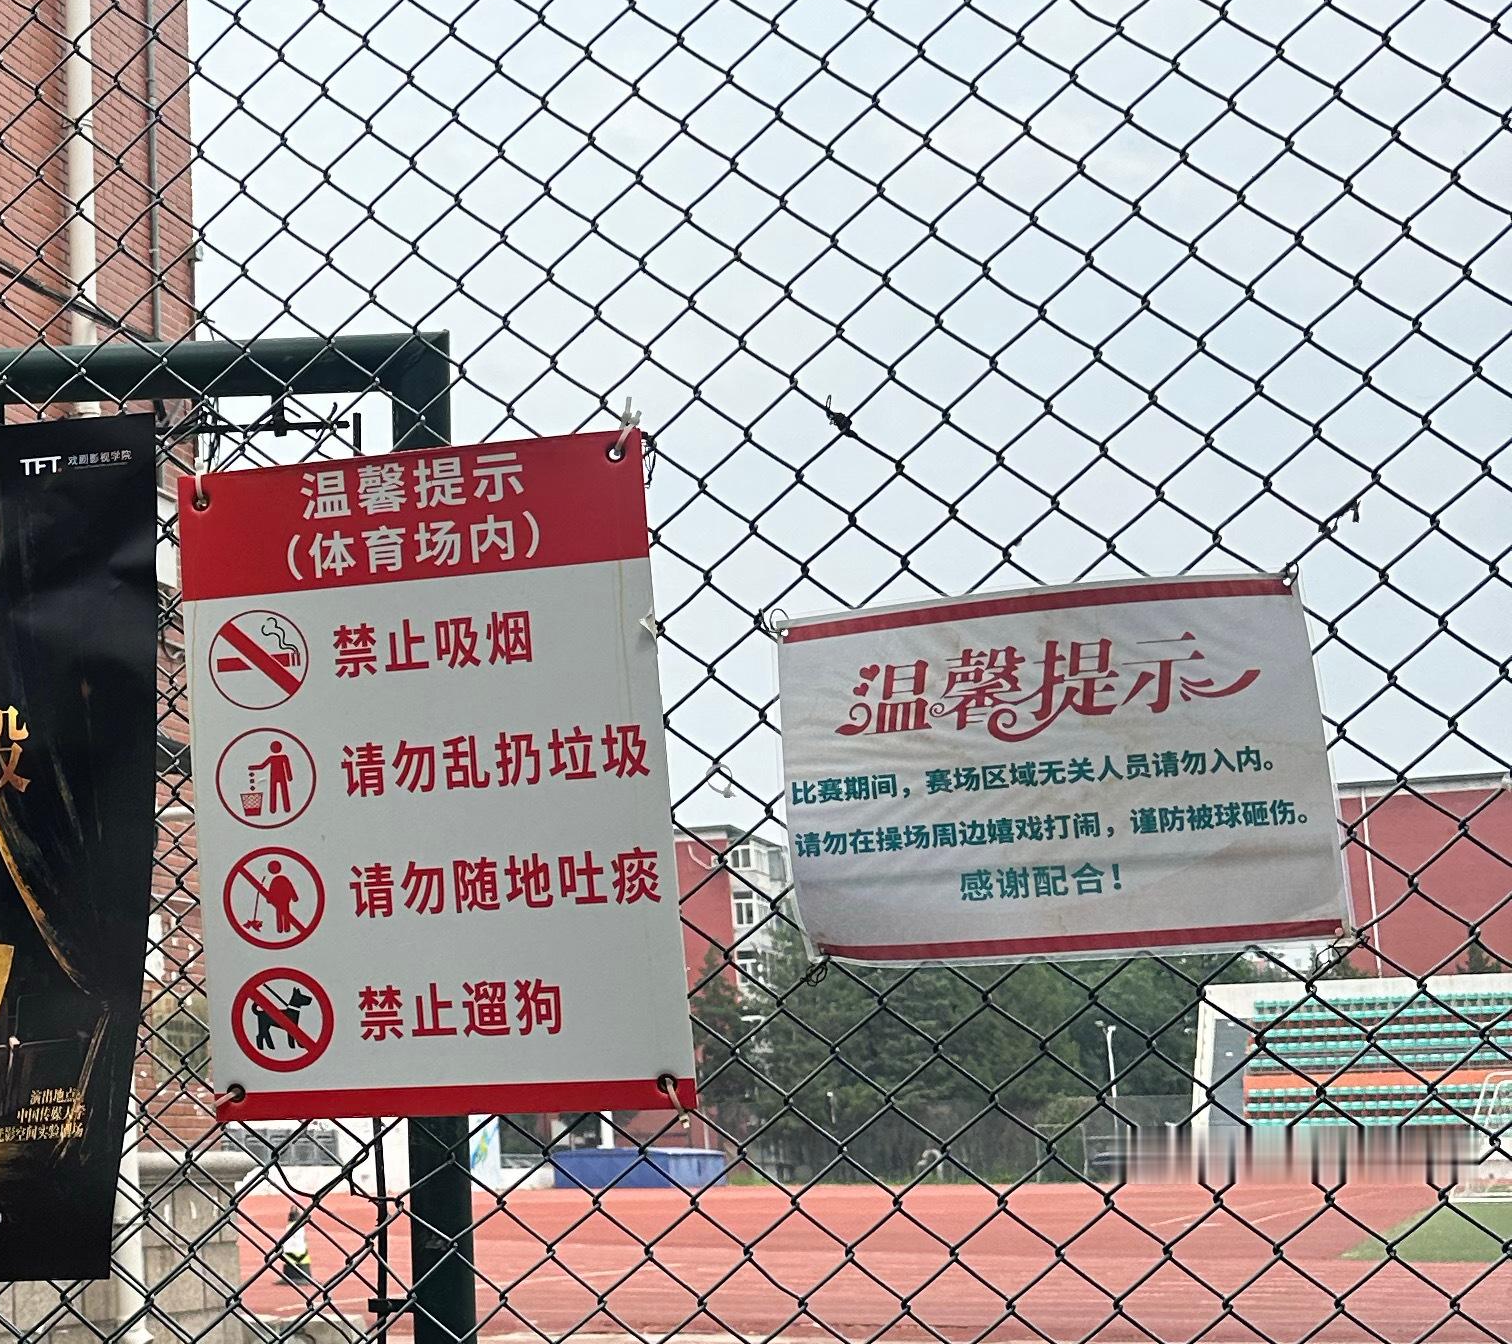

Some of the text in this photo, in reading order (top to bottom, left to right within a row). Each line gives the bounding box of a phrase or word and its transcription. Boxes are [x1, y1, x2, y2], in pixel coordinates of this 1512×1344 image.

[299, 451, 525, 522] 温馨提示
[286, 509, 543, 582] （体育场内）
[332, 610, 534, 680] 禁止吸烟
[834, 630, 1262, 743] 温馨提示
[340, 723, 652, 799] 请勿乱扔垃圾
[349, 846, 663, 920] 请勿随地吐痰
[959, 862, 1124, 903] 感谢配合！
[357, 978, 564, 1042] 禁止遛狗
